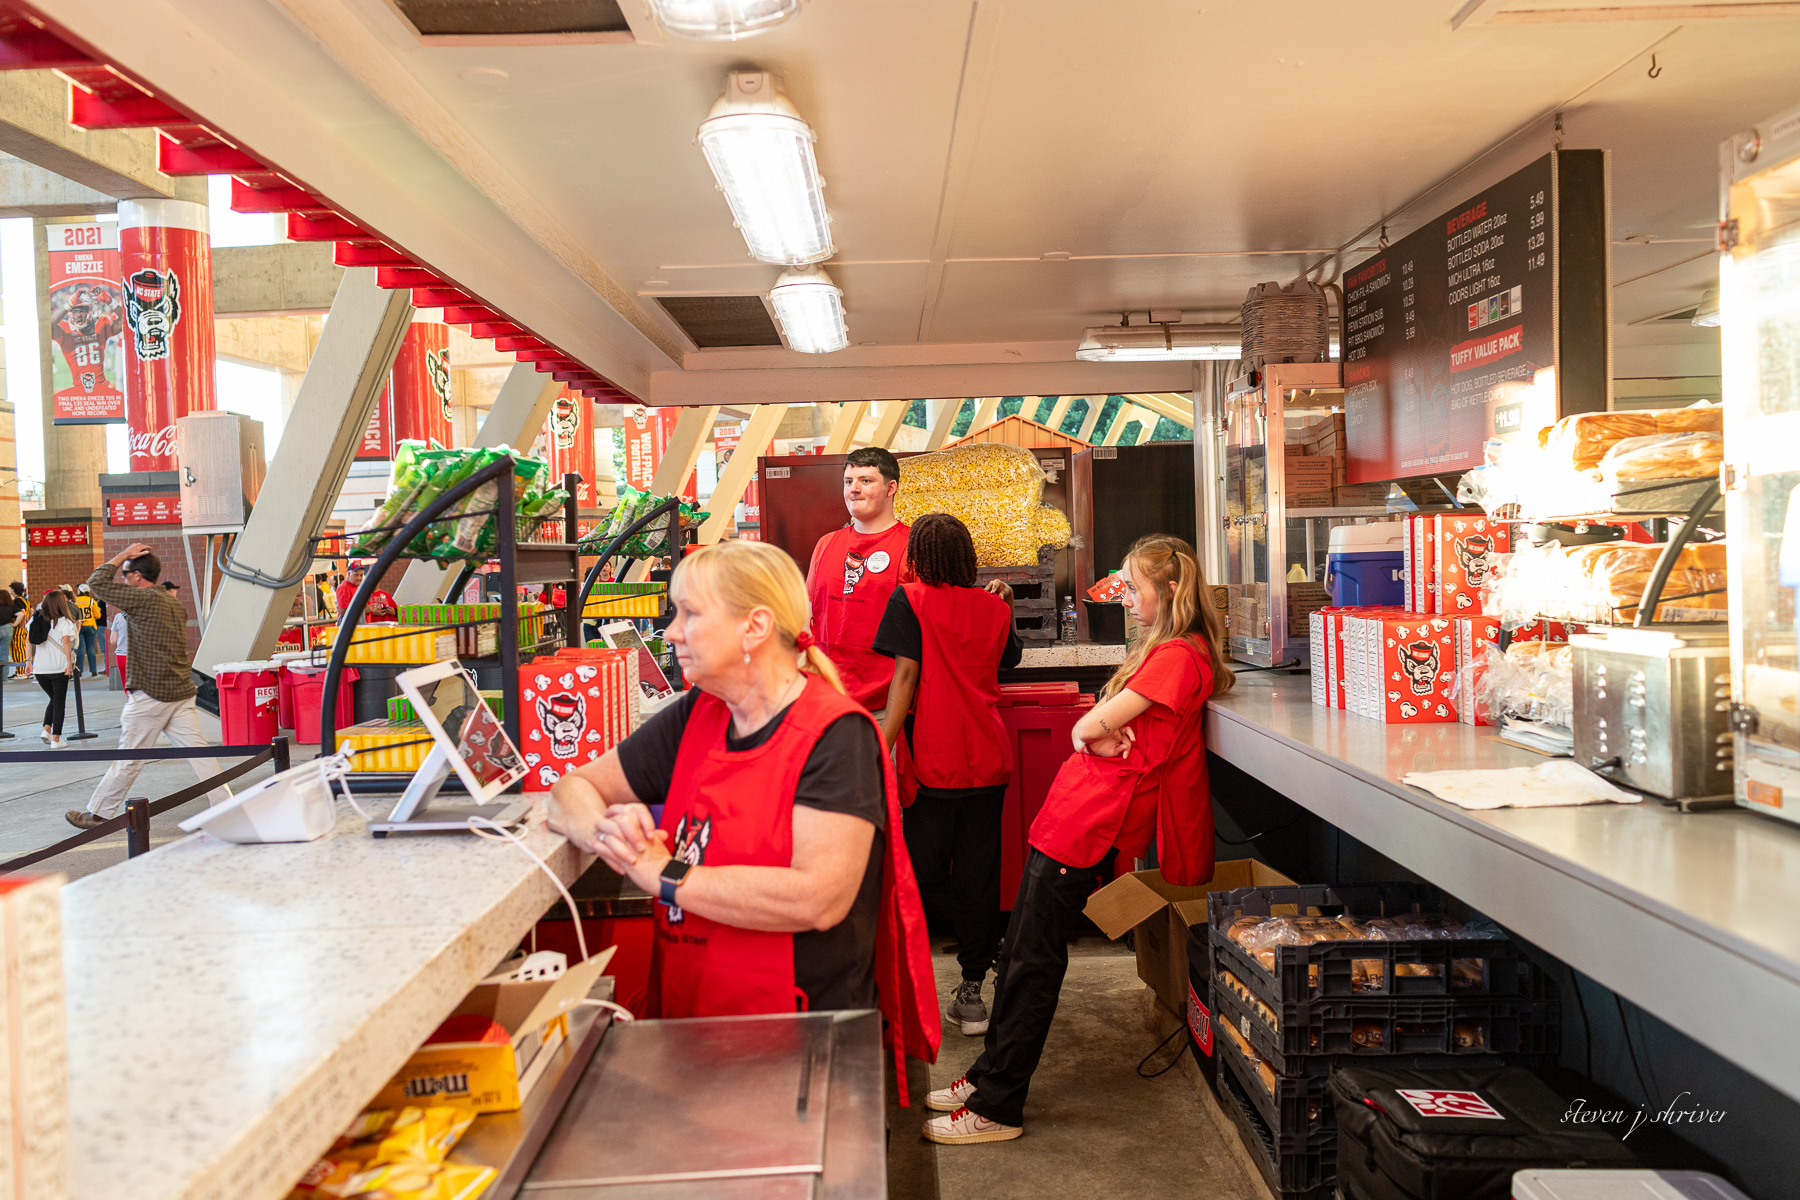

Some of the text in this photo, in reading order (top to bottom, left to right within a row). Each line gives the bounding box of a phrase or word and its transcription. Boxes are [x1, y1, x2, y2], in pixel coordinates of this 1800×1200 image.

[1530, 191, 1544, 210] 5.49
[1447, 201, 1487, 235] BEVERAGE
[1530, 211, 1544, 230] 5.99
[64, 227, 101, 246] 2021
[1448, 213, 1507, 252] BOTTLED WATER 20oz
[1528, 232, 1544, 251] 13.29
[74, 254, 93, 262] EMEKA
[1448, 234, 1504, 270] BOTTLED SODA 20oz
[1528, 252, 1545, 271] 11.49
[65, 262, 104, 274] EMEZIE
[1358, 259, 1386, 283] FAVORITES
[1402, 260, 1413, 275] 10.49
[1448, 258, 1495, 288] MICH ULTRA 16oz
[137, 286, 161, 297] NC STATE
[1348, 273, 1390, 303] CHICK-FIL-A SANDWICH
[1449, 275, 1500, 305] COORS LIGHT 16oz
[1348, 300, 1367, 318] PIZZA HUT
[1348, 308, 1384, 333] PENN STATION SUB
[1355, 333, 1363, 345] BBQ
[1364, 323, 1384, 341] SANDWICH
[75, 342, 100, 366] 86
[1348, 347, 1366, 361] HOT DOG
[1451, 332, 1520, 366] TUFFY VALUE PACK
[1349, 366, 1370, 383] SNACKS
[1451, 382, 1461, 394] HOT
[1474, 372, 1497, 389] BOTTLED
[1349, 379, 1377, 396] POPCORN BOX
[1451, 388, 1505, 410] BAG OF KETTLE CHIPS
[129, 425, 179, 457] oca-Co
[631, 439, 641, 482] FOOTBALL
[641, 432, 653, 488] WOLFPACK
